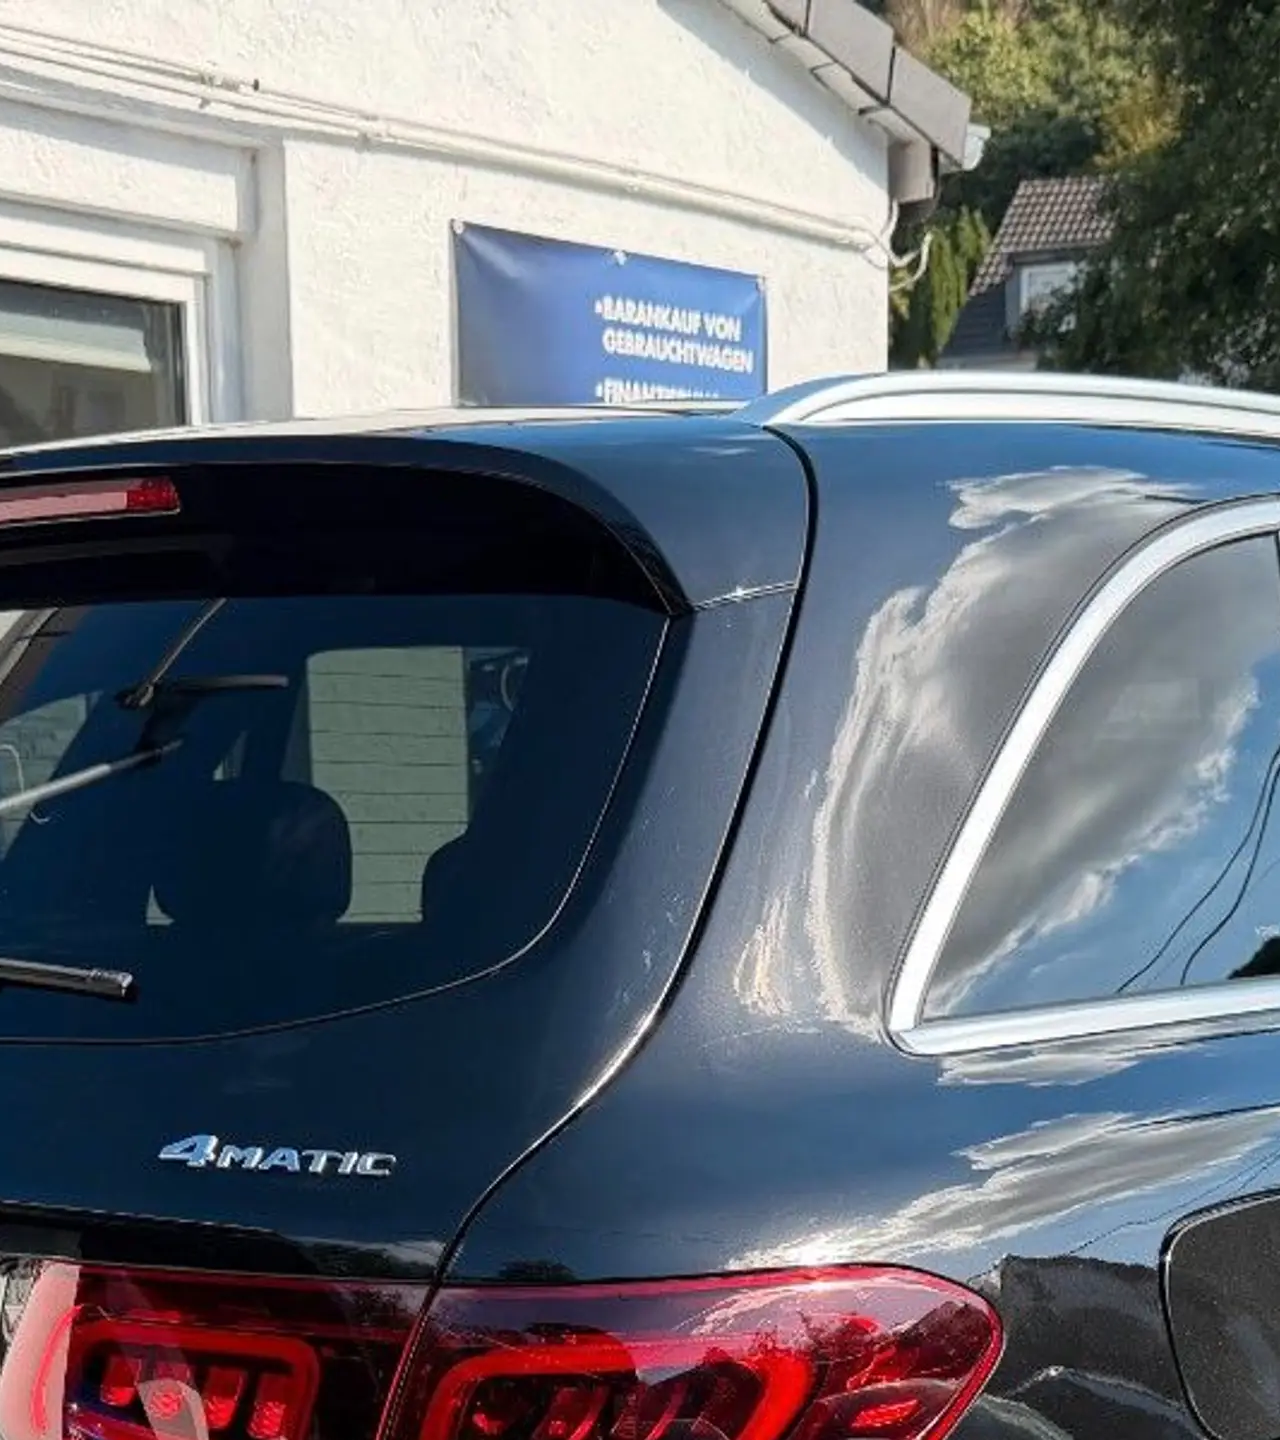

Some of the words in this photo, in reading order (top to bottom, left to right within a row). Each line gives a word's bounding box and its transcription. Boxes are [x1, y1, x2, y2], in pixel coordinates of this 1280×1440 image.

[602, 295, 701, 336] BARANKAUF
[702, 312, 741, 342] VON
[602, 327, 754, 375] GEBRAUCHTWAGEN
[158, 1133, 398, 1176] 4MATIC
